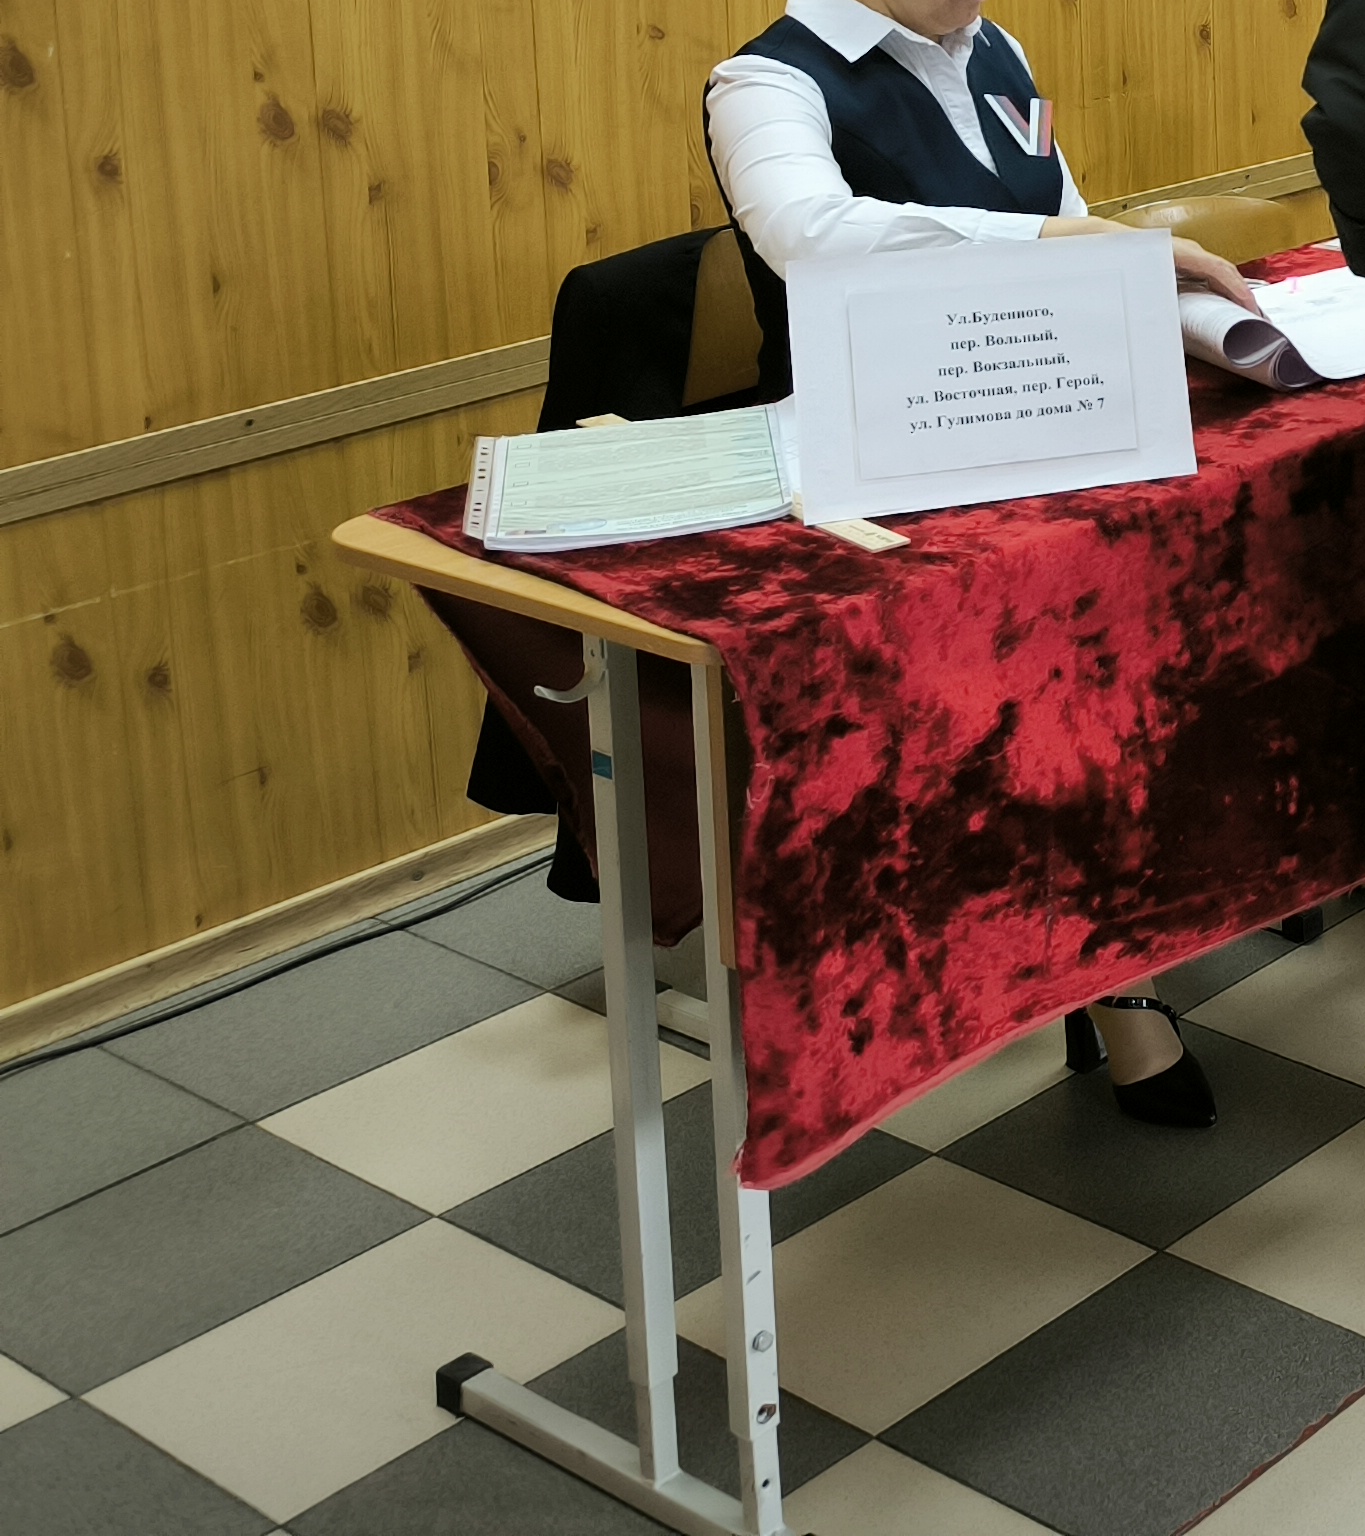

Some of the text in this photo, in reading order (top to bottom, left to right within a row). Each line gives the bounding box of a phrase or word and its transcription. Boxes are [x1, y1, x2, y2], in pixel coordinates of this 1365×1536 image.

[950, 329, 1058, 351] пер. Вольный,
[938, 352, 1070, 378] пер. Вокзальный,
[906, 373, 1104, 408] ул. Восточная, пер. Герой,
[909, 397, 1105, 434] ул. Гулимова до дома № 7
